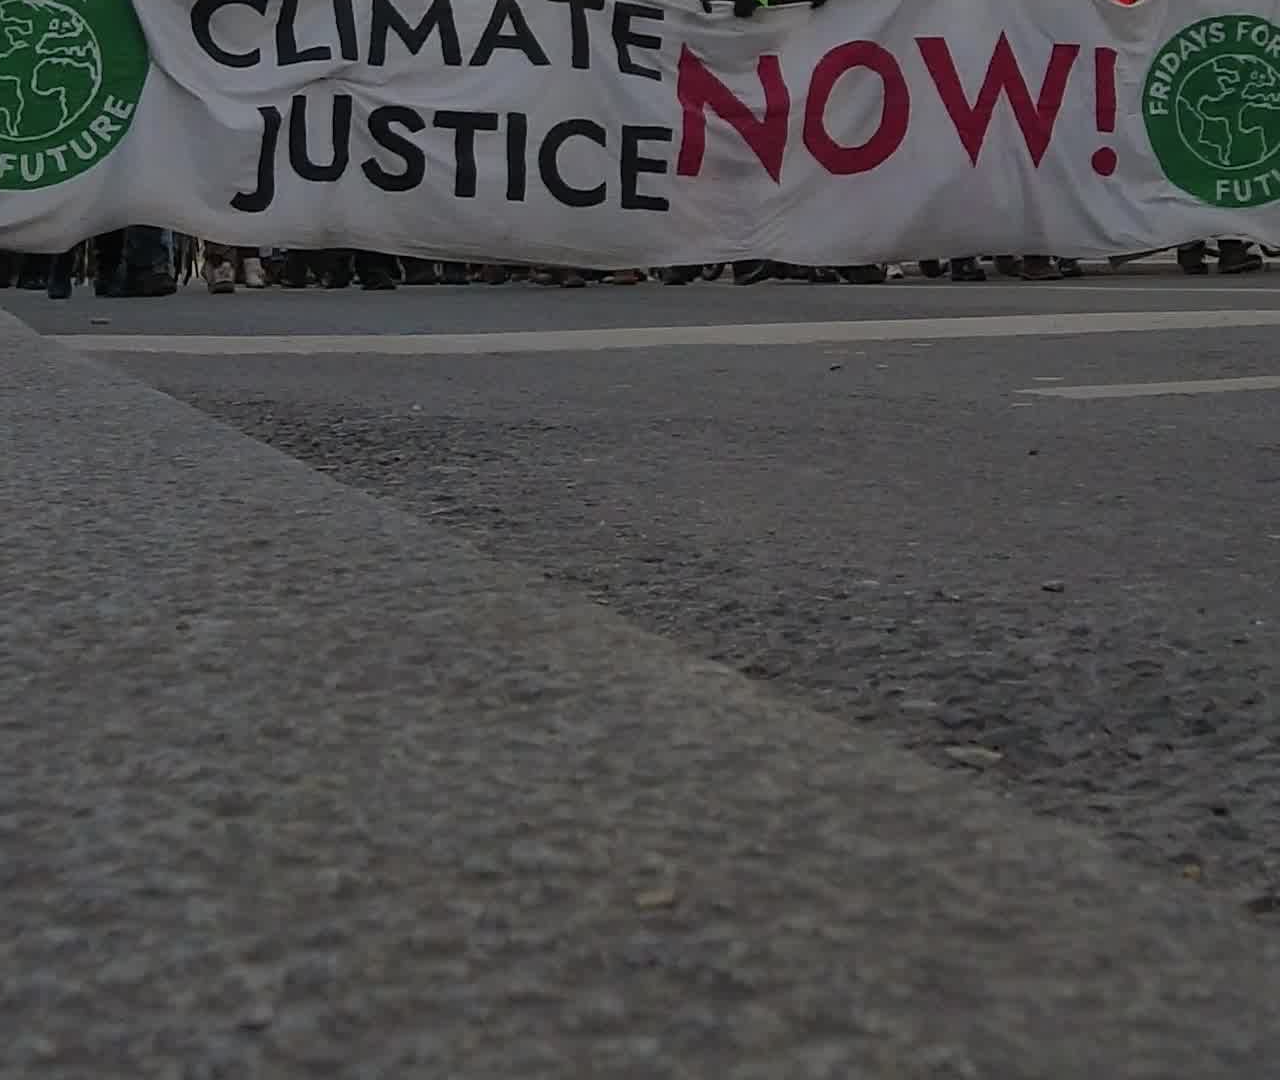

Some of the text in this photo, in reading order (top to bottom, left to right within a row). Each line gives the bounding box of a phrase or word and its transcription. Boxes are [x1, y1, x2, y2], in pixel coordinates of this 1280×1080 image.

[677, 30, 1118, 184] NOW!
[1148, 22, 1226, 117] FRIDAYS
[230, 94, 673, 214] JUSTICE
